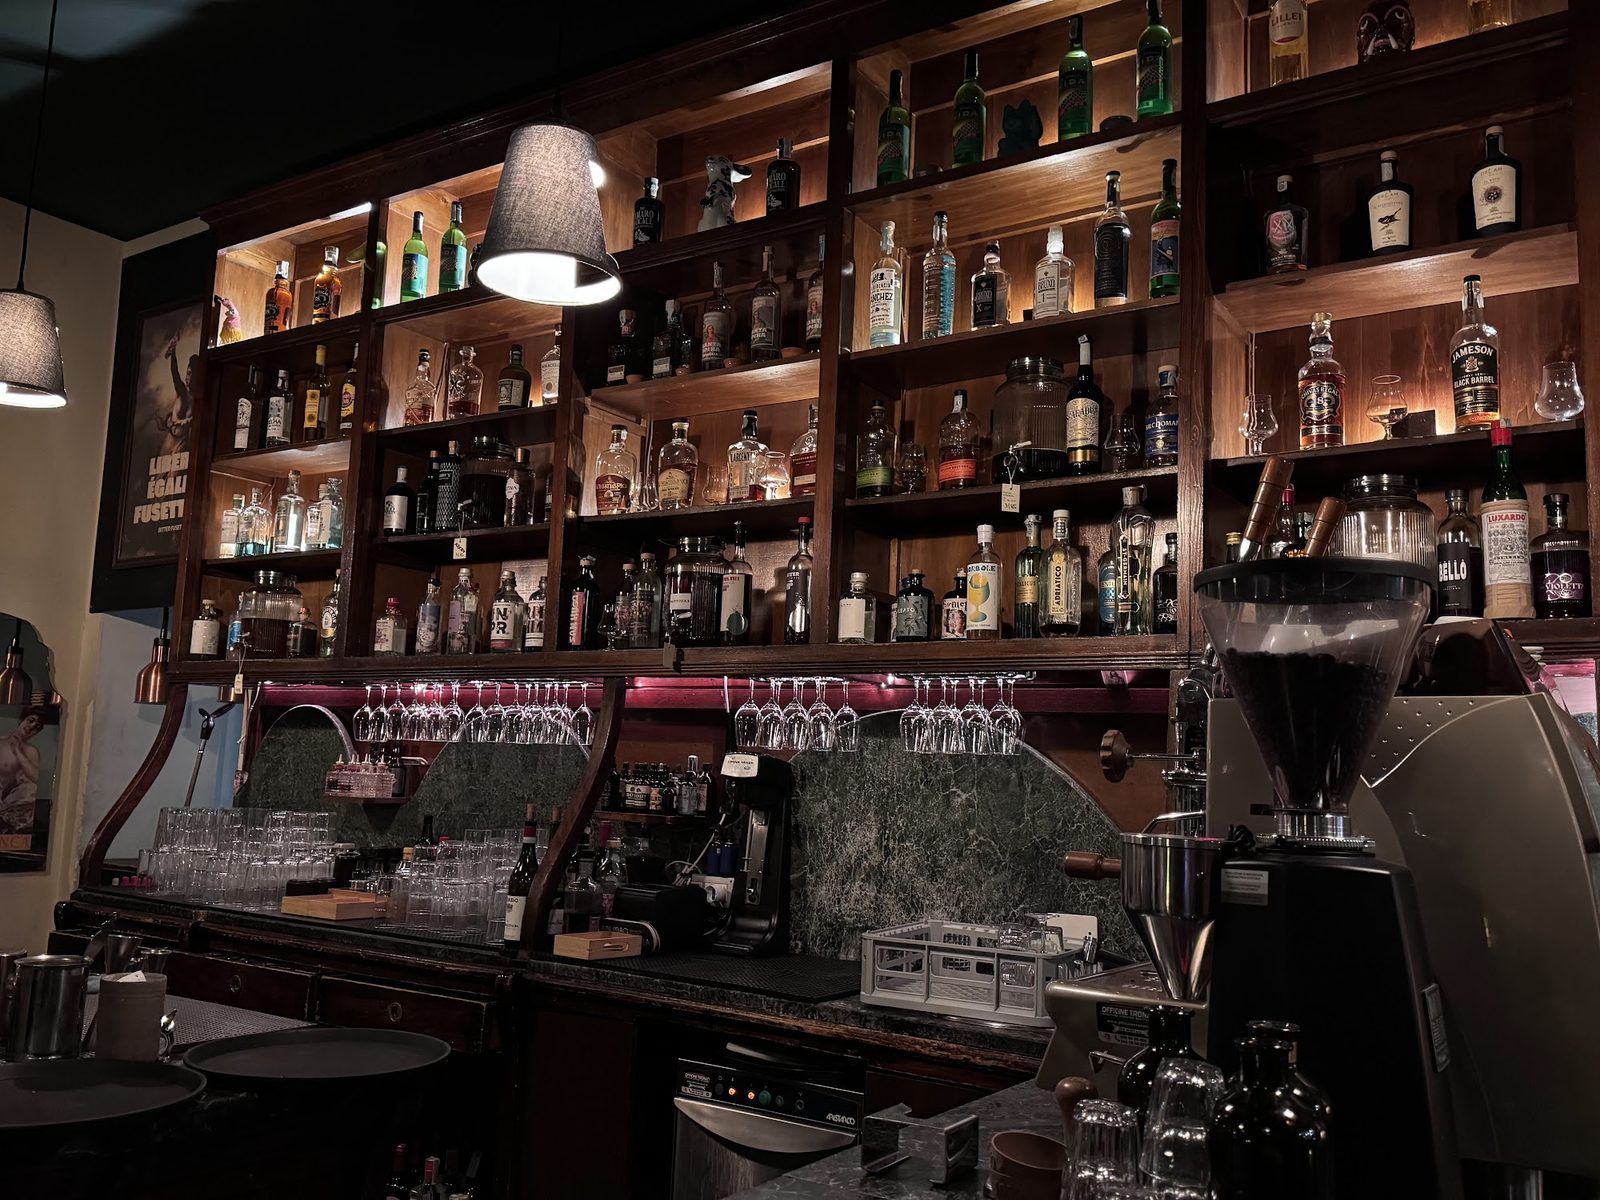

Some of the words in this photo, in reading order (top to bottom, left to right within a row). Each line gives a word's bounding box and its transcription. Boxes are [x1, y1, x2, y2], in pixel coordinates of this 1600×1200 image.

[1271, 12, 1302, 26] LILLET
[1452, 345, 1494, 364] JAMESON
[1454, 377, 1470, 389] BLACK
[1471, 375, 1495, 384] BARREL
[148, 451, 190, 476] LIBER
[133, 498, 185, 524] FUSETT
[1488, 513, 1526, 523] LUXARDO
[1102, 1006, 1129, 1016] OFFICINE
